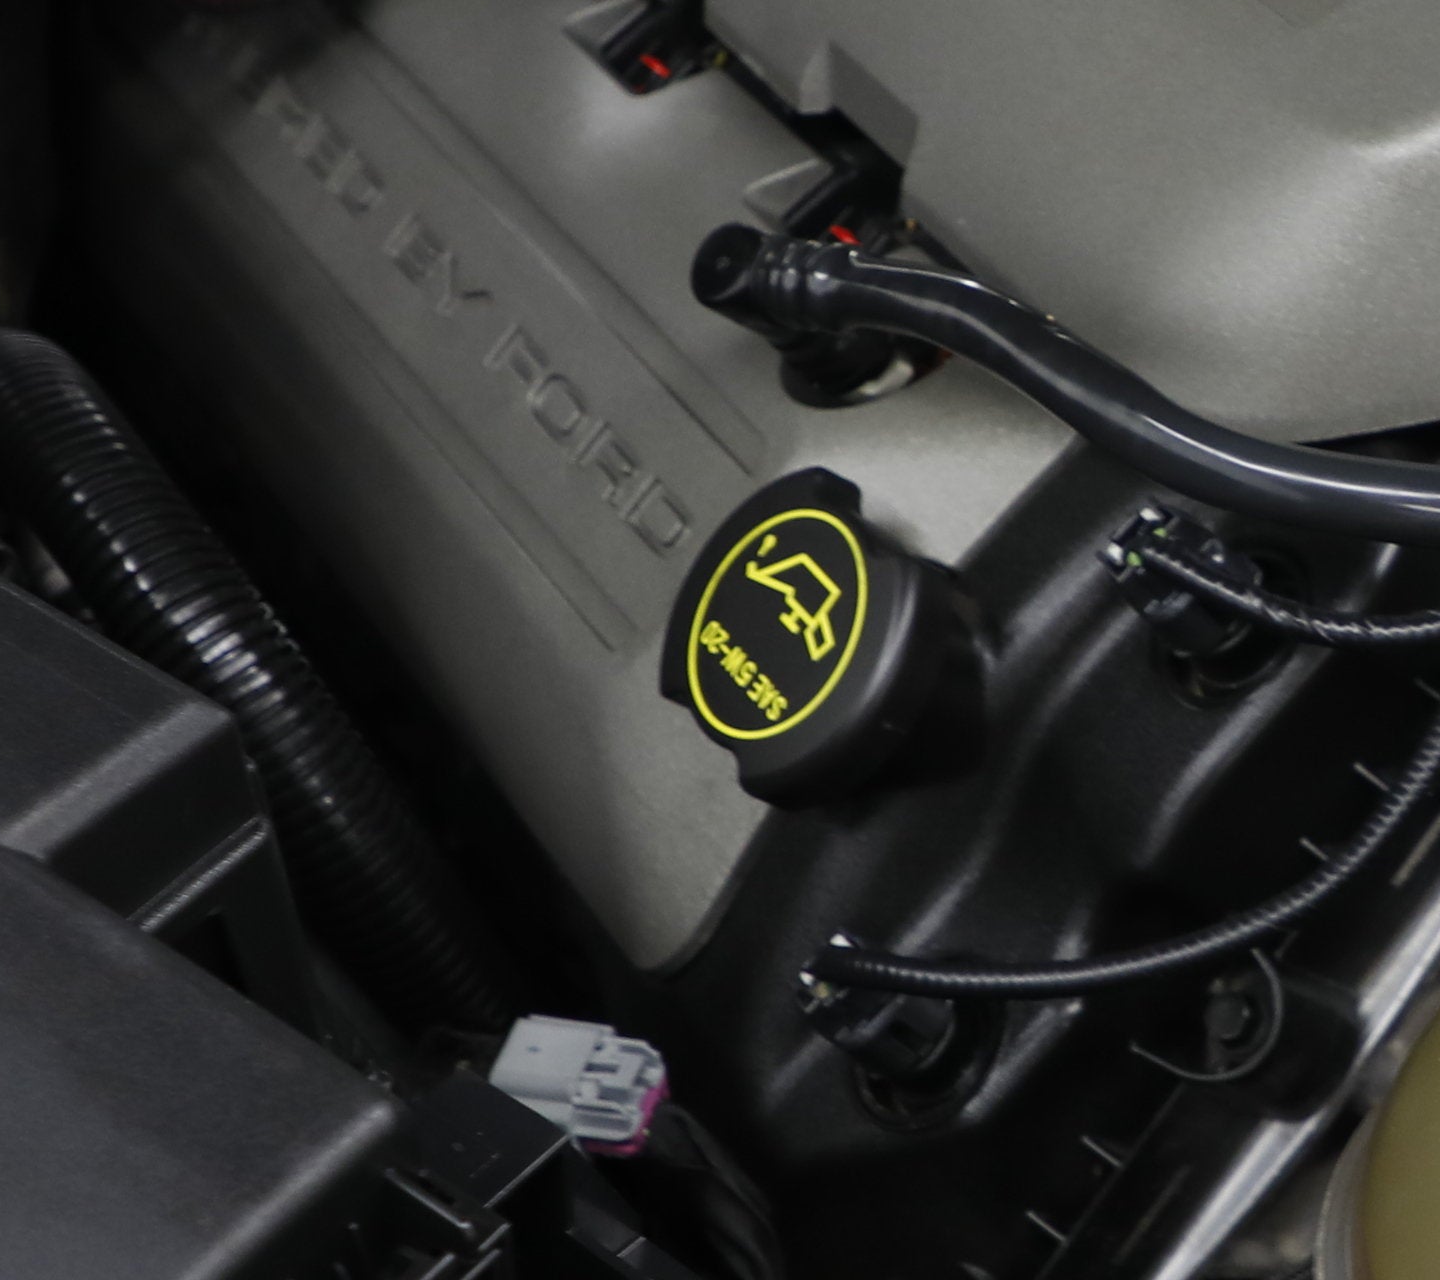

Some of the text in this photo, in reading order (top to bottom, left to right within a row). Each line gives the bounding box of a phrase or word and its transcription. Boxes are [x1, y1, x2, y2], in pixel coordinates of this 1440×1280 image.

[482, 324, 692, 557] FORD
[699, 619, 789, 722] SAE 5W-20
